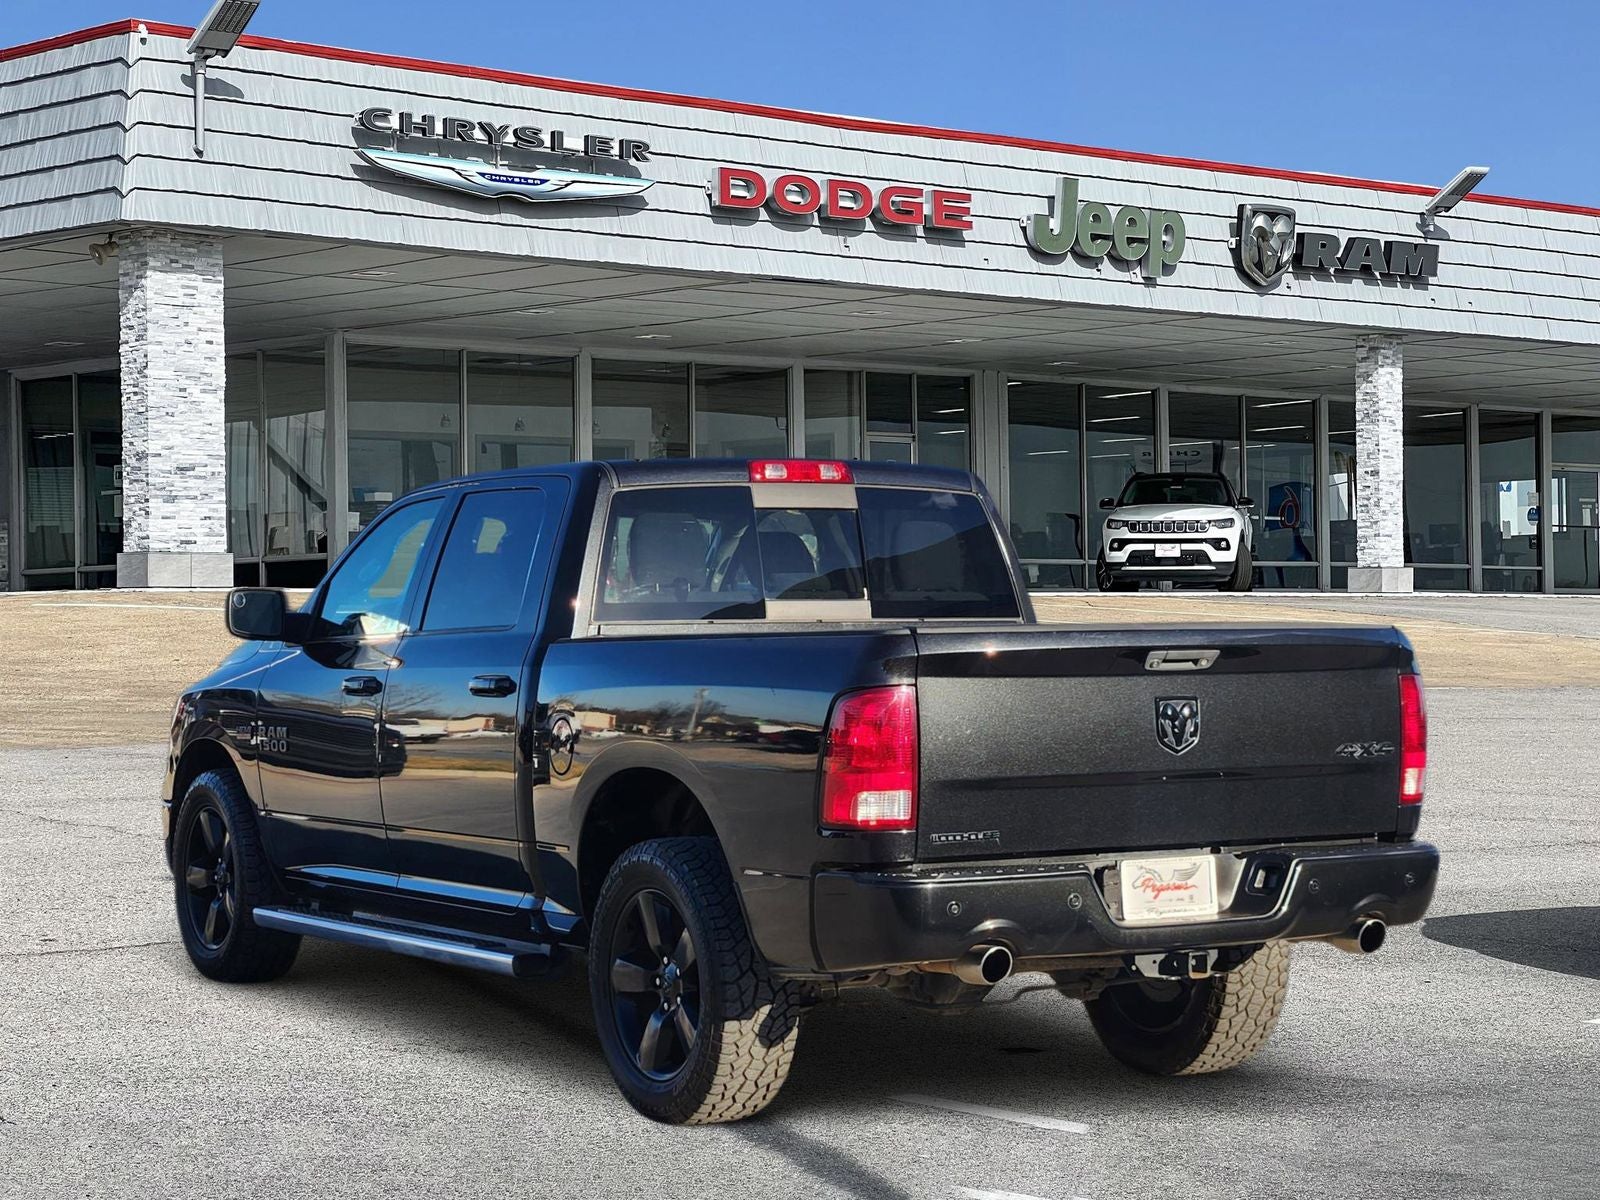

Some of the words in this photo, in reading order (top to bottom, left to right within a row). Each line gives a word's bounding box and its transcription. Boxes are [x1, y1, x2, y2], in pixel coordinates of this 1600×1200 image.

[359, 107, 650, 162] CHRYSLER
[484, 174, 541, 185] CHRYSLER
[712, 167, 973, 230] DODGE
[1027, 177, 1186, 278] Jeep
[1298, 232, 1439, 277] RAM
[257, 726, 288, 739] RAM
